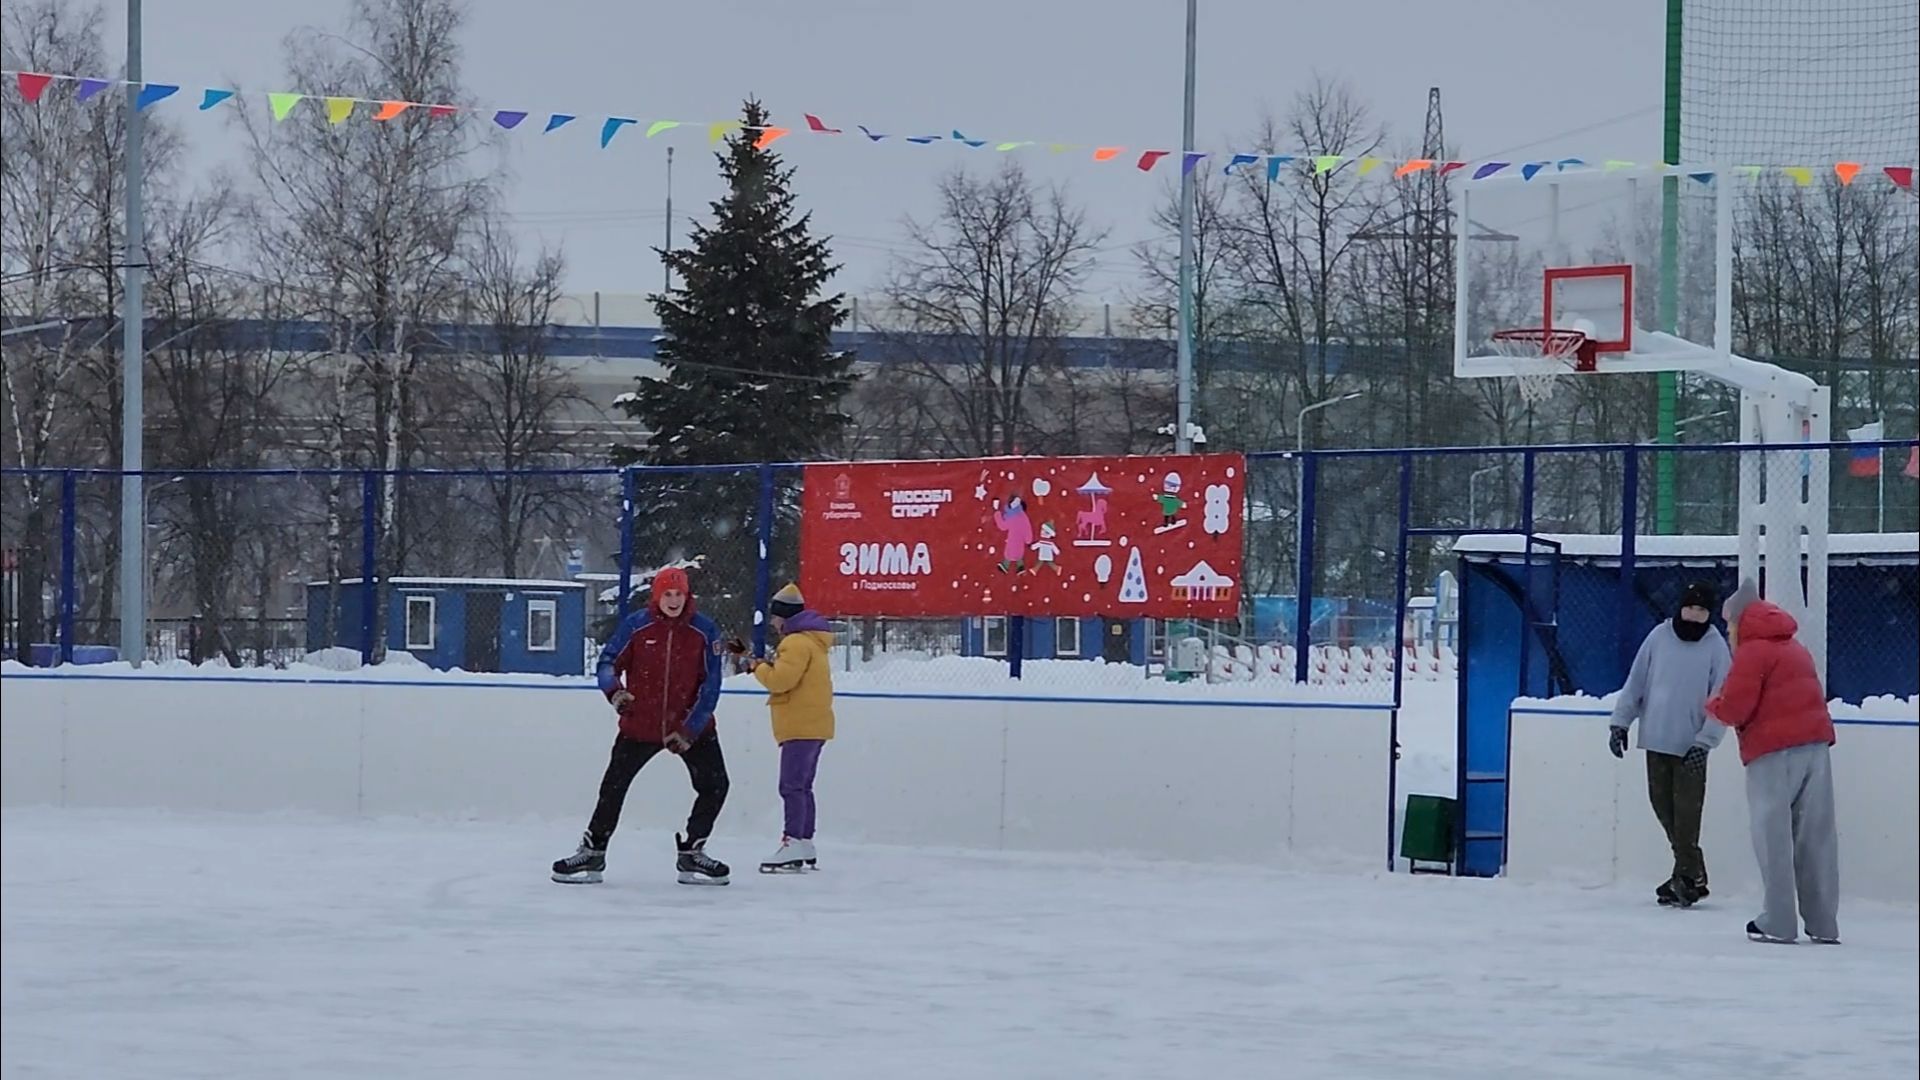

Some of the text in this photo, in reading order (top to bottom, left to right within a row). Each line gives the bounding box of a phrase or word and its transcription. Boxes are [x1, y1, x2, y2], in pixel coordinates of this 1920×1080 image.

[892, 489, 952, 503] МОСОБЛ
[892, 504, 939, 517] СПОРТ
[840, 542, 931, 575] ЗИМА
[860, 579, 916, 591] Подмосковье
